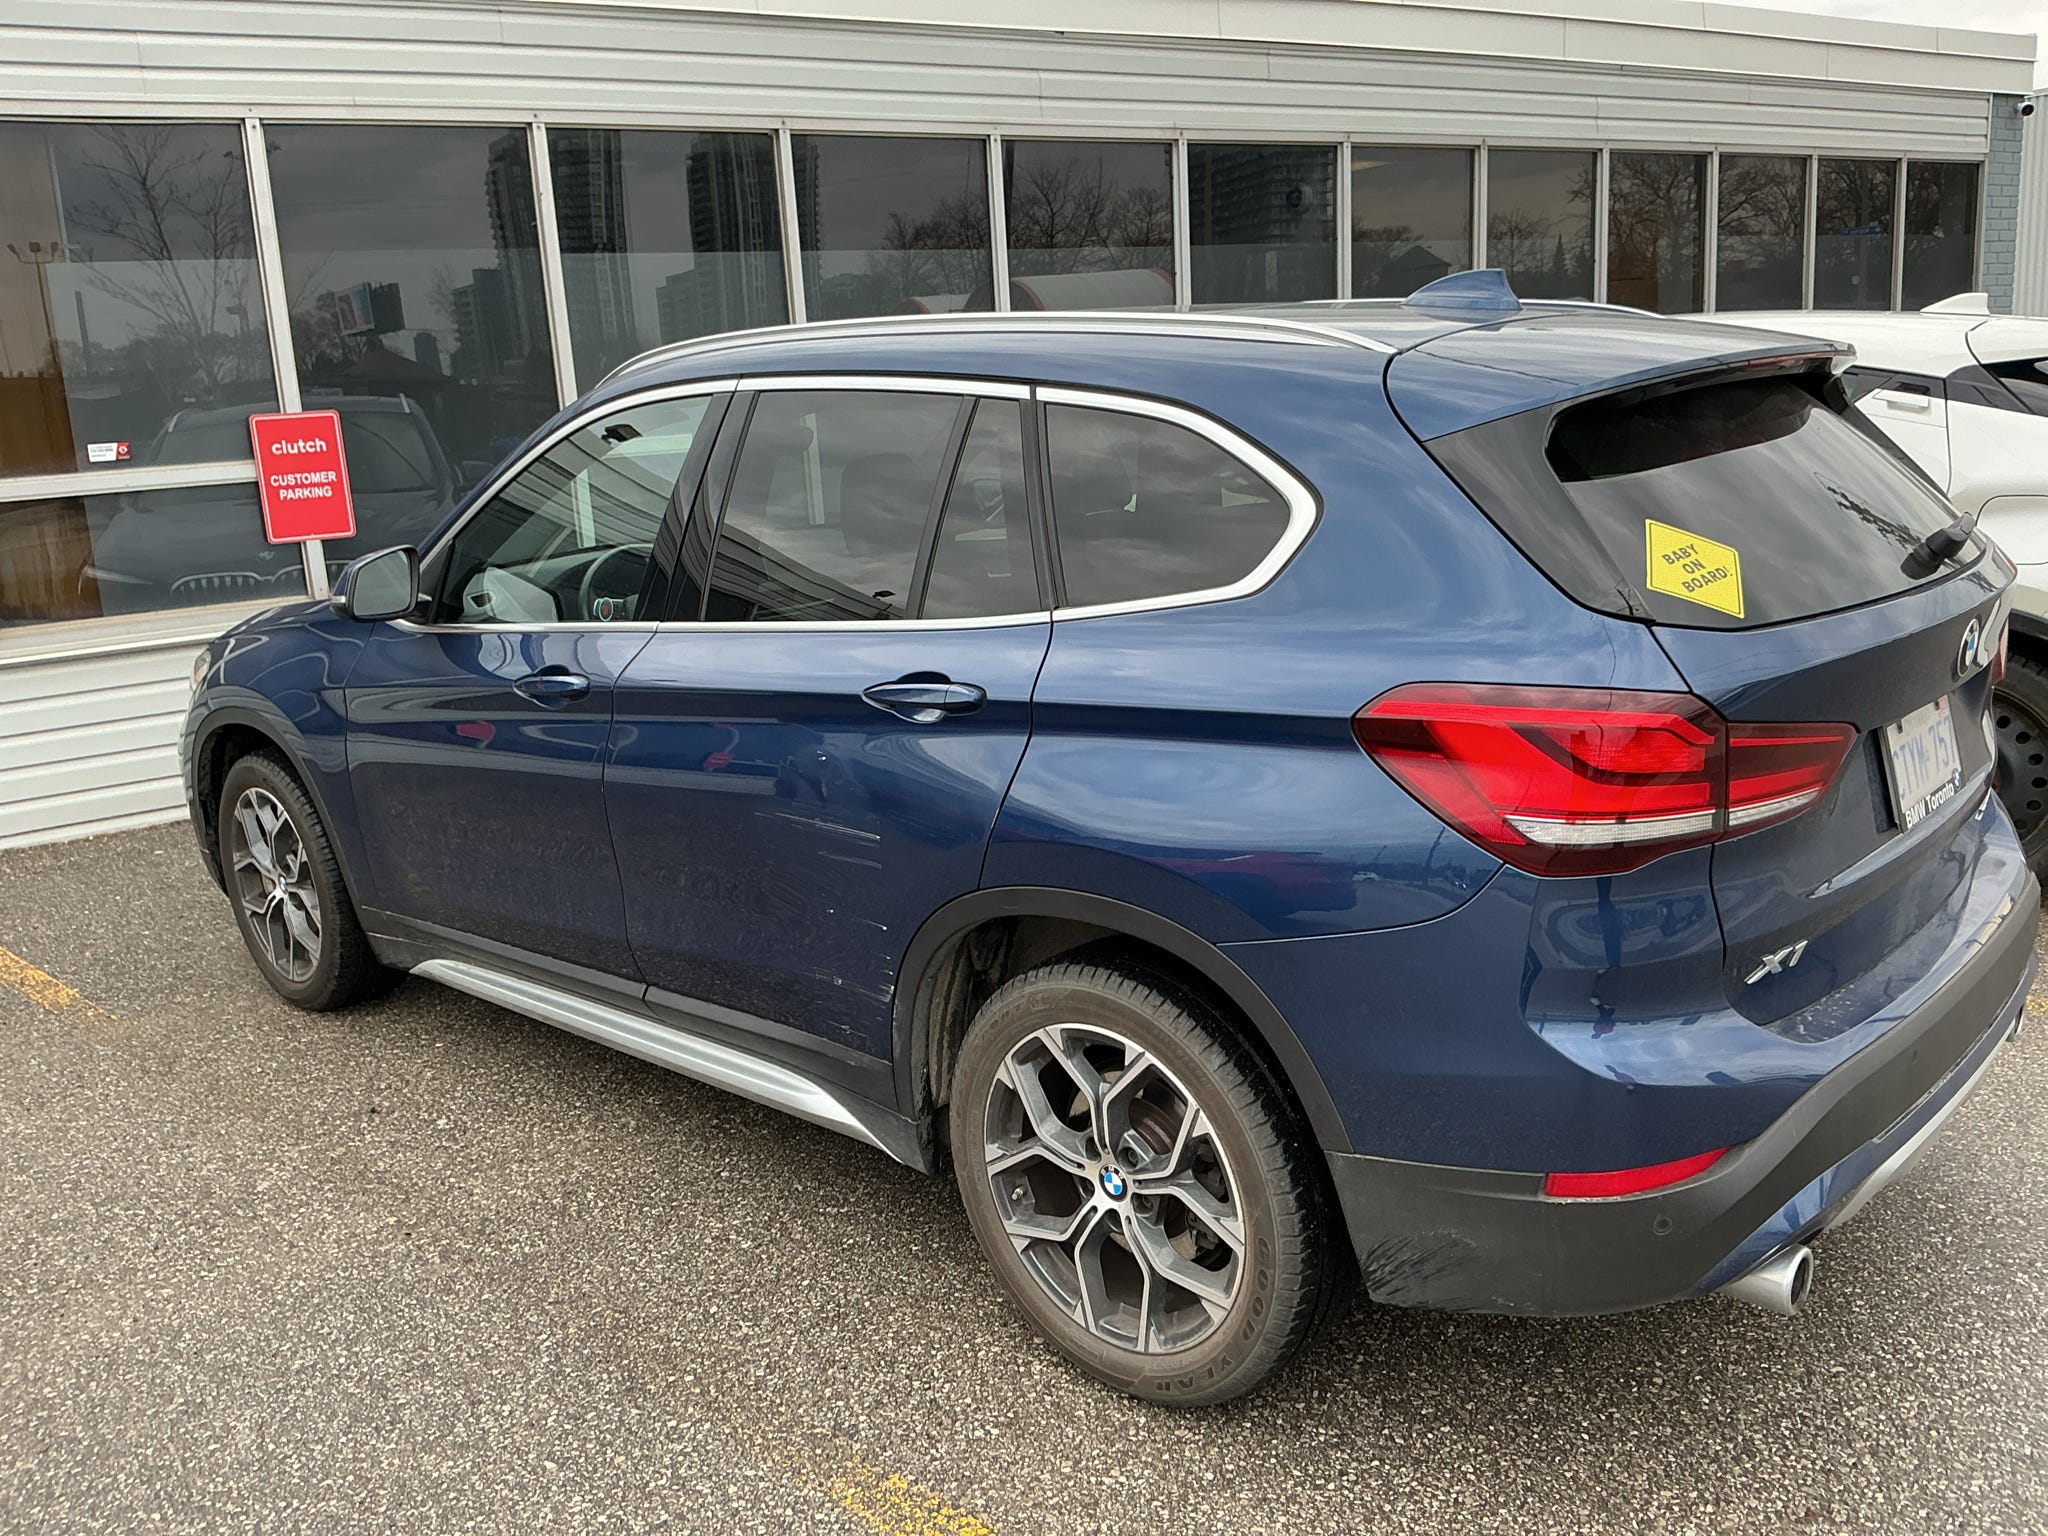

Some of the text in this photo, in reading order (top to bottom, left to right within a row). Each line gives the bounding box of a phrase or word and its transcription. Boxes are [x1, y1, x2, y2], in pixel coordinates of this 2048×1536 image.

[271, 438, 327, 455] clutch
[270, 471, 337, 487] CUSTOMER
[279, 485, 333, 501] PARKING
[1661, 543, 1698, 565] BABY
[1681, 558, 1706, 574] ON
[1681, 566, 1734, 593] BOARD!
[1904, 782, 1955, 829] BMW Toronto
[1744, 939, 1809, 985] X1
